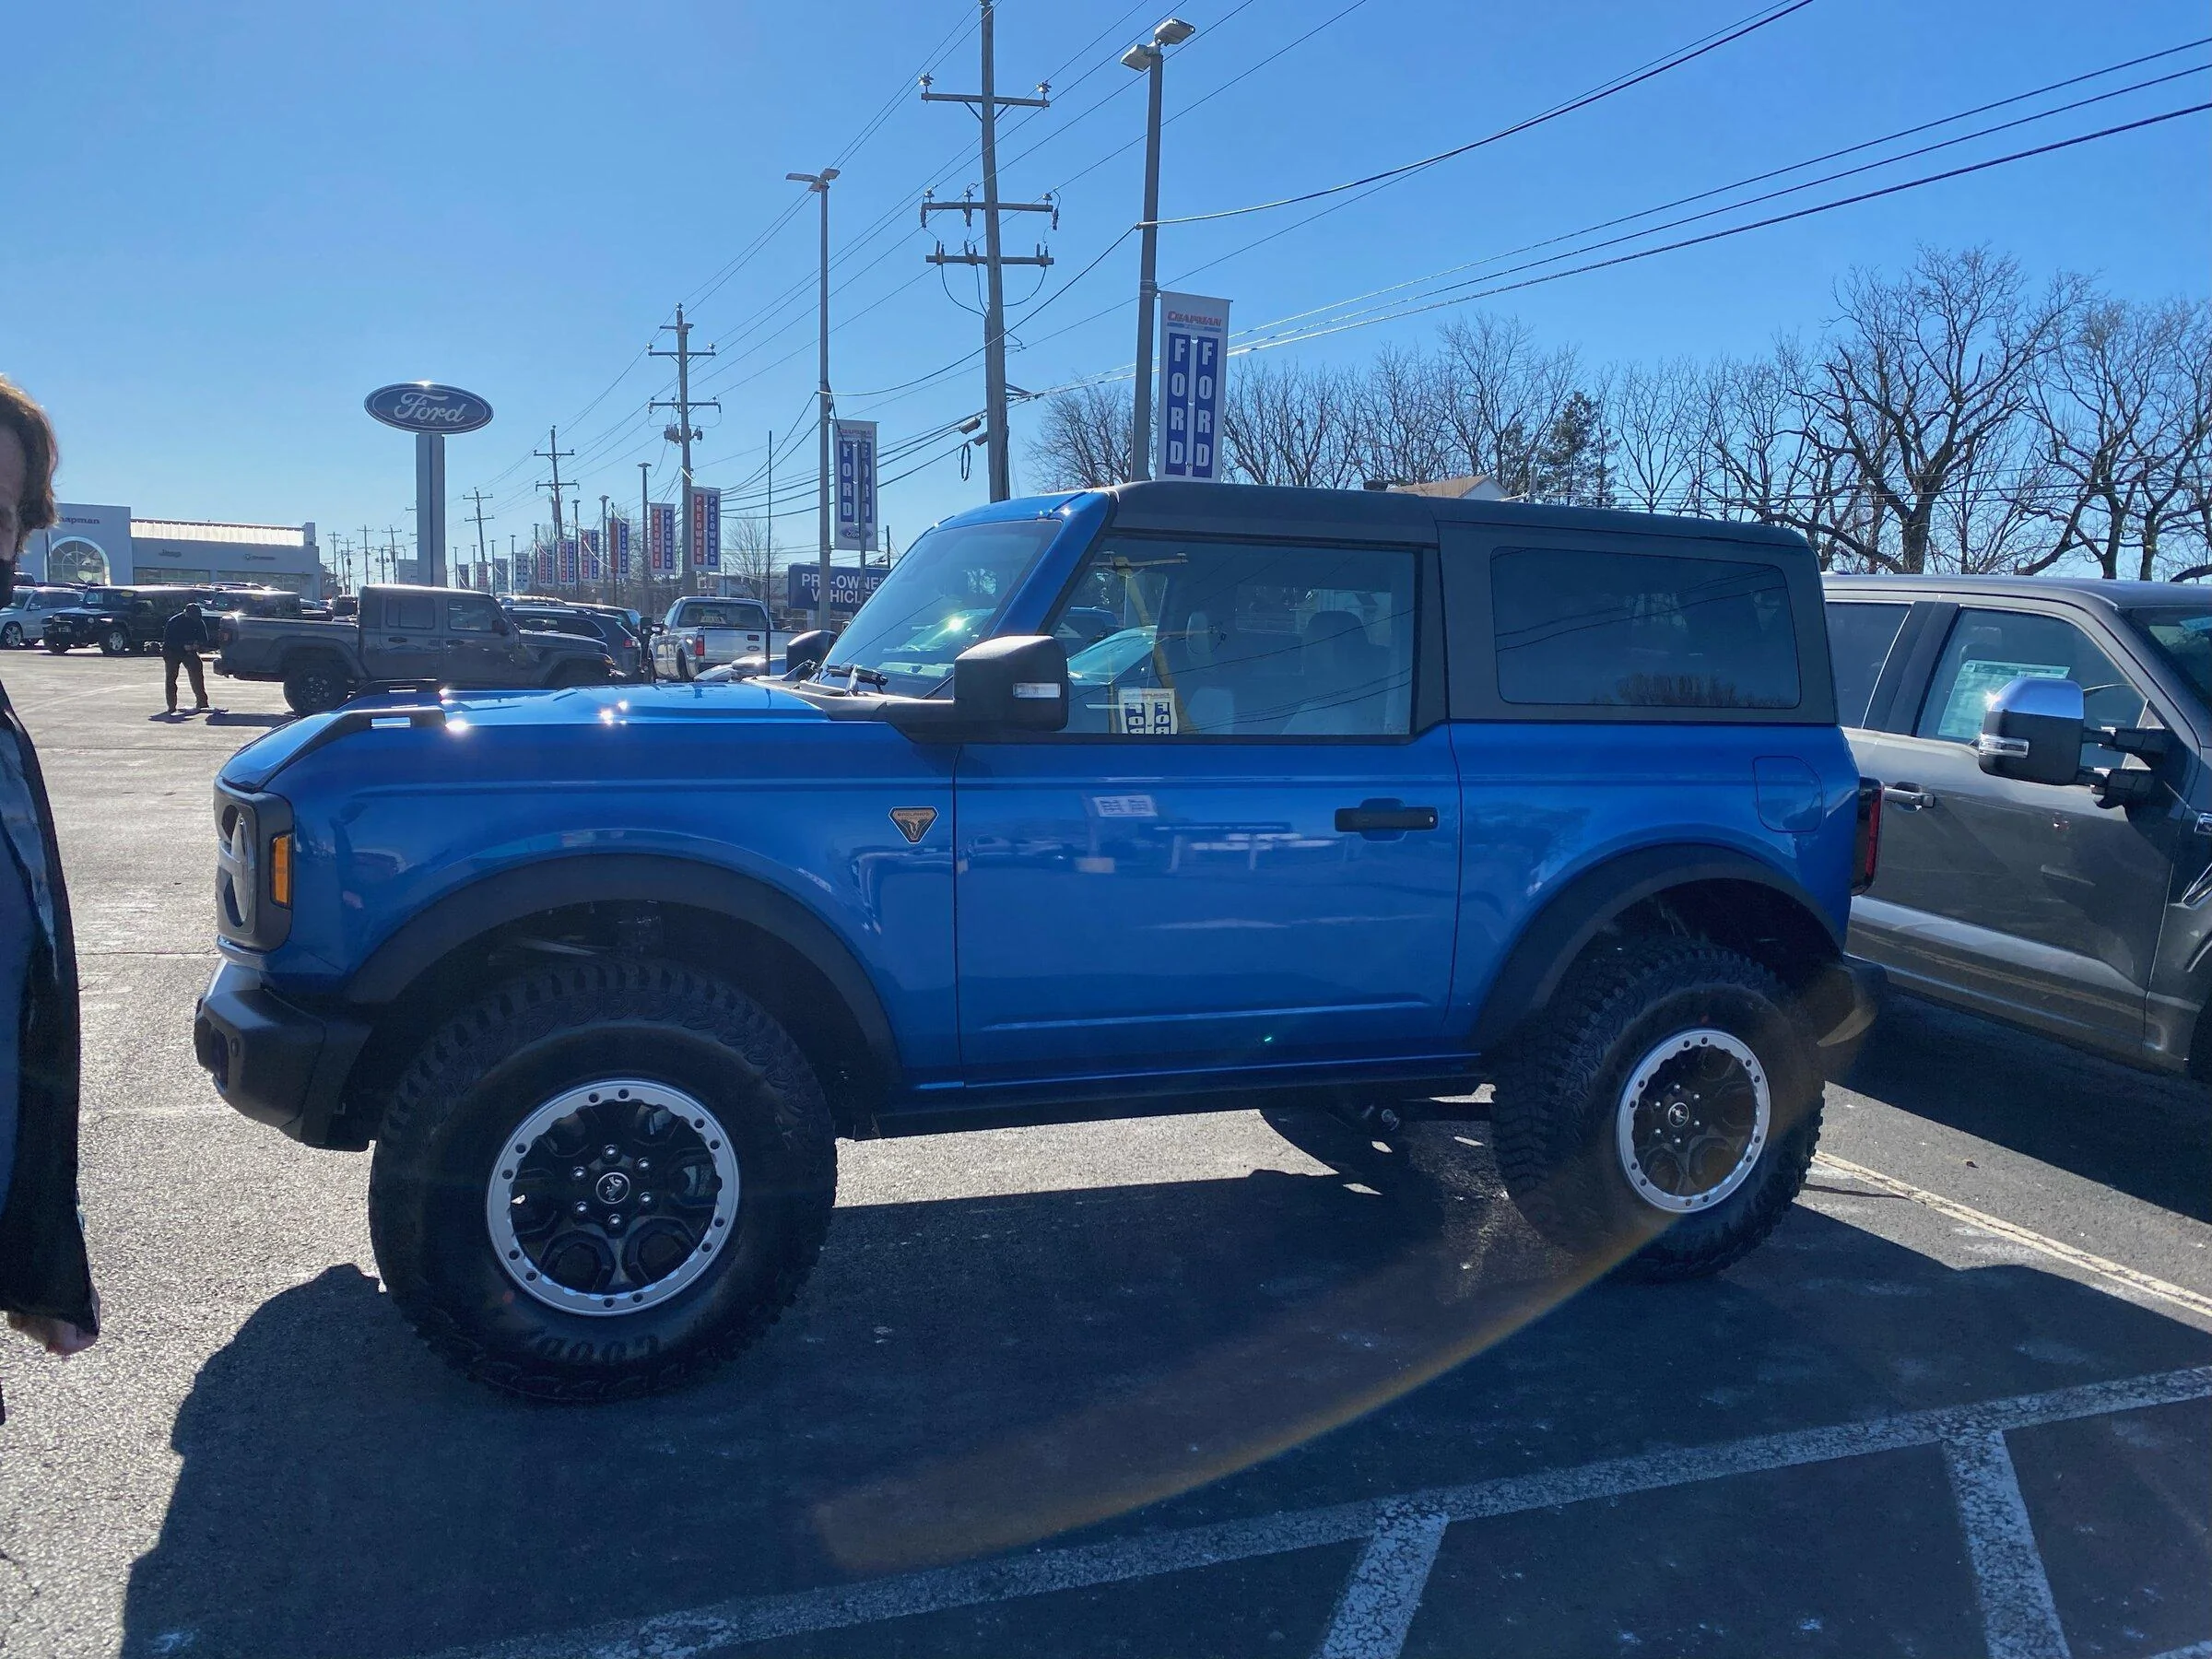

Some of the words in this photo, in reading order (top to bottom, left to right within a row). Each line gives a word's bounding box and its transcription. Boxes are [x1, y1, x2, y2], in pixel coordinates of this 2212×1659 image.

[394, 392, 467, 422] Ford
[1170, 337, 1186, 465] FORD
[1195, 341, 1213, 467] FORD
[841, 442, 853, 516] FORD
[708, 497, 717, 563] PREOWNED
[801, 573, 886, 591] PR-OWNE
[811, 588, 873, 606] VHICL
